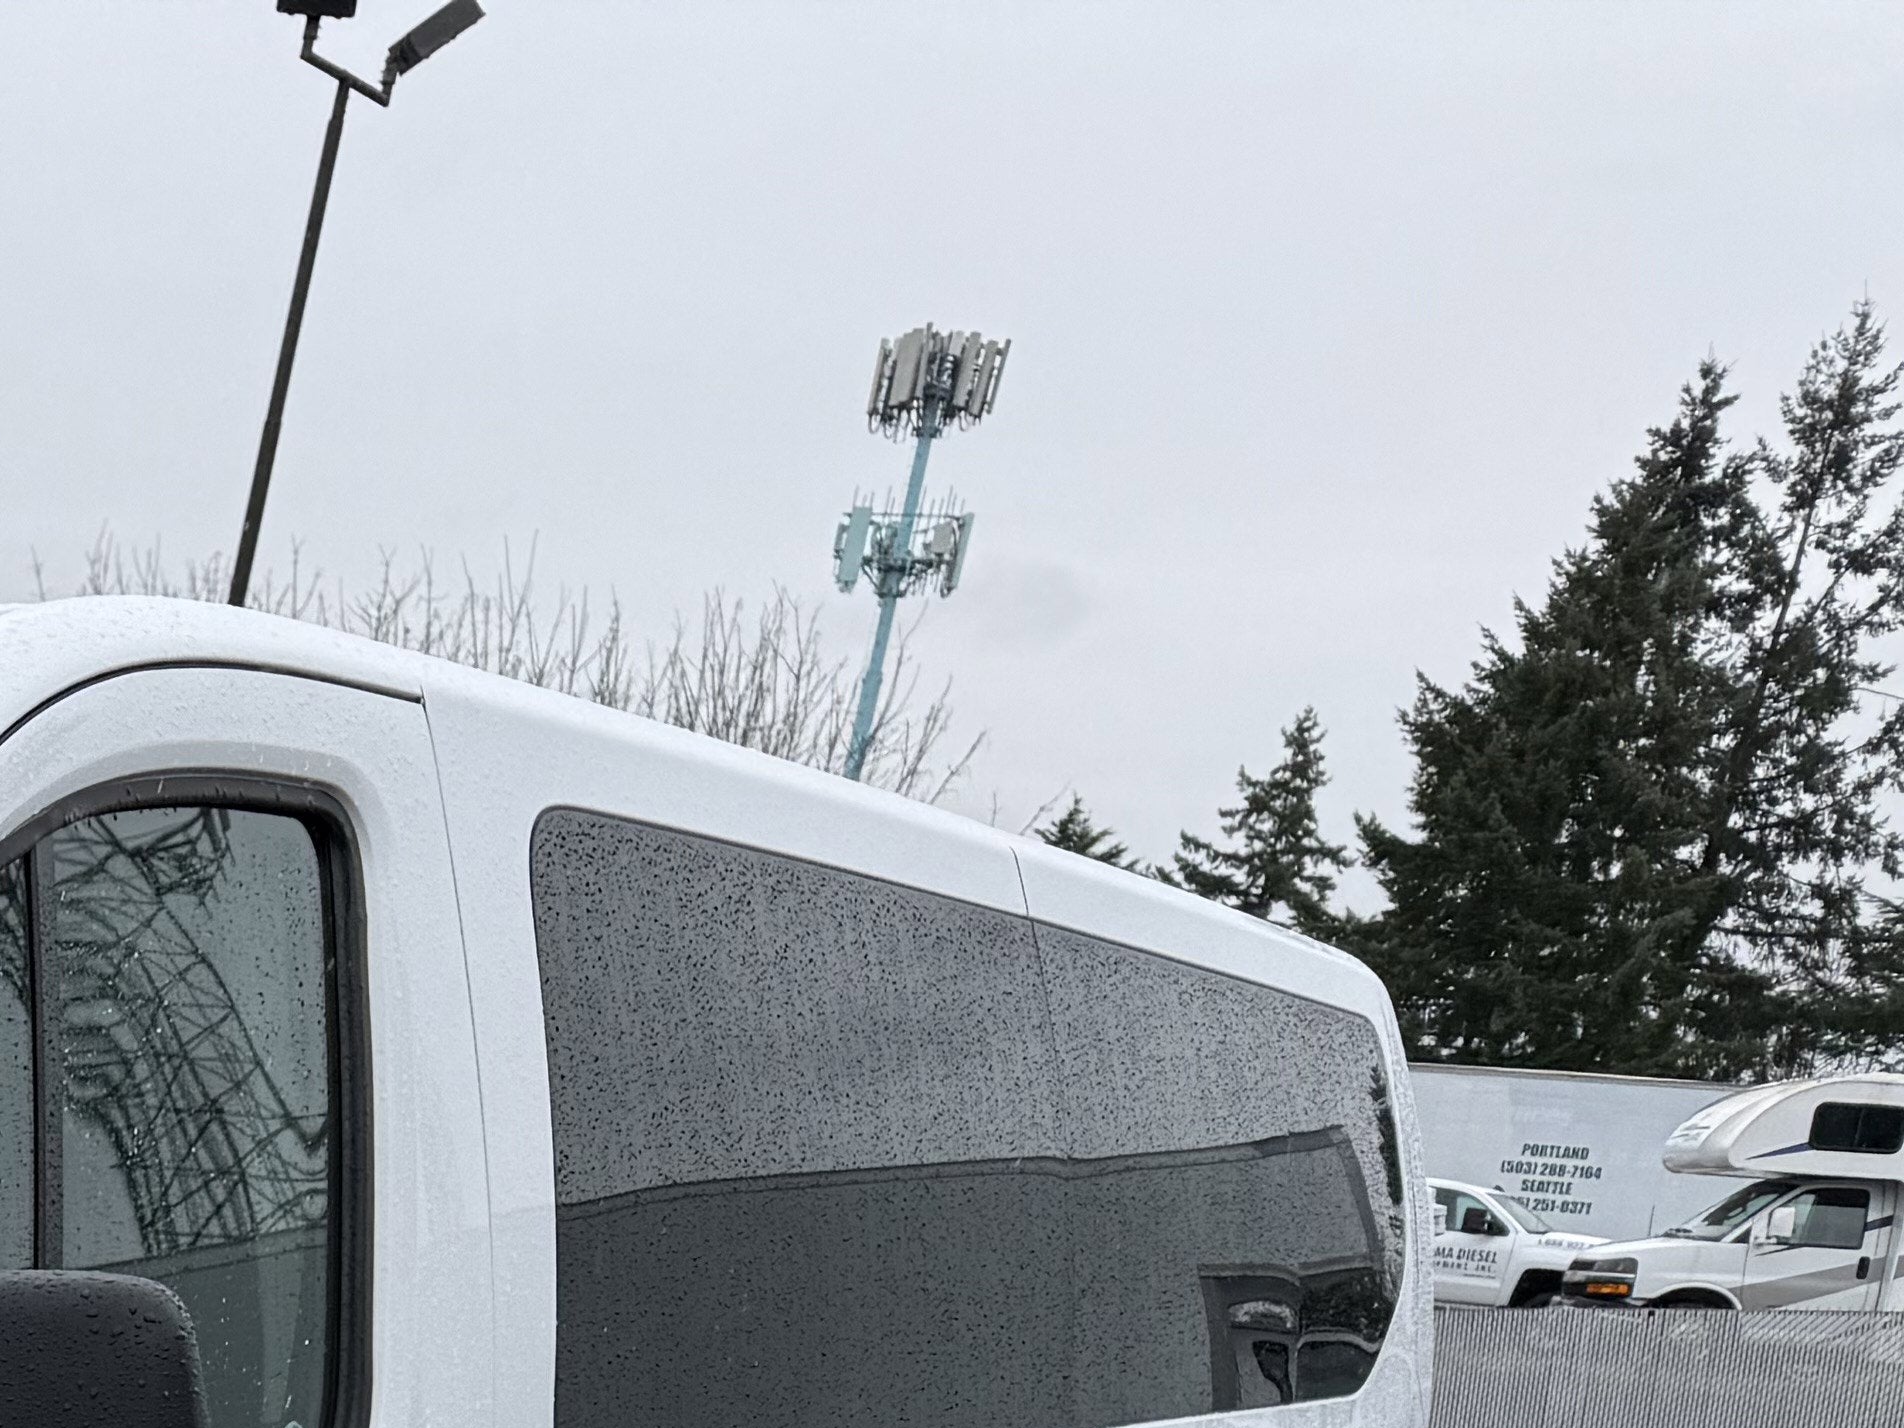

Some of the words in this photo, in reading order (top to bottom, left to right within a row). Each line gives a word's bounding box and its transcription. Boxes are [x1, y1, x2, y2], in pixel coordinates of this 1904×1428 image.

[1521, 1143, 1589, 1160] PORTLAND
[1500, 1160, 1538, 1175] (503)
[1521, 1179, 1573, 1195] SEATTLE
[1533, 1198, 1592, 1215] 251-0371
[1456, 1248, 1498, 1264] DIESEL
